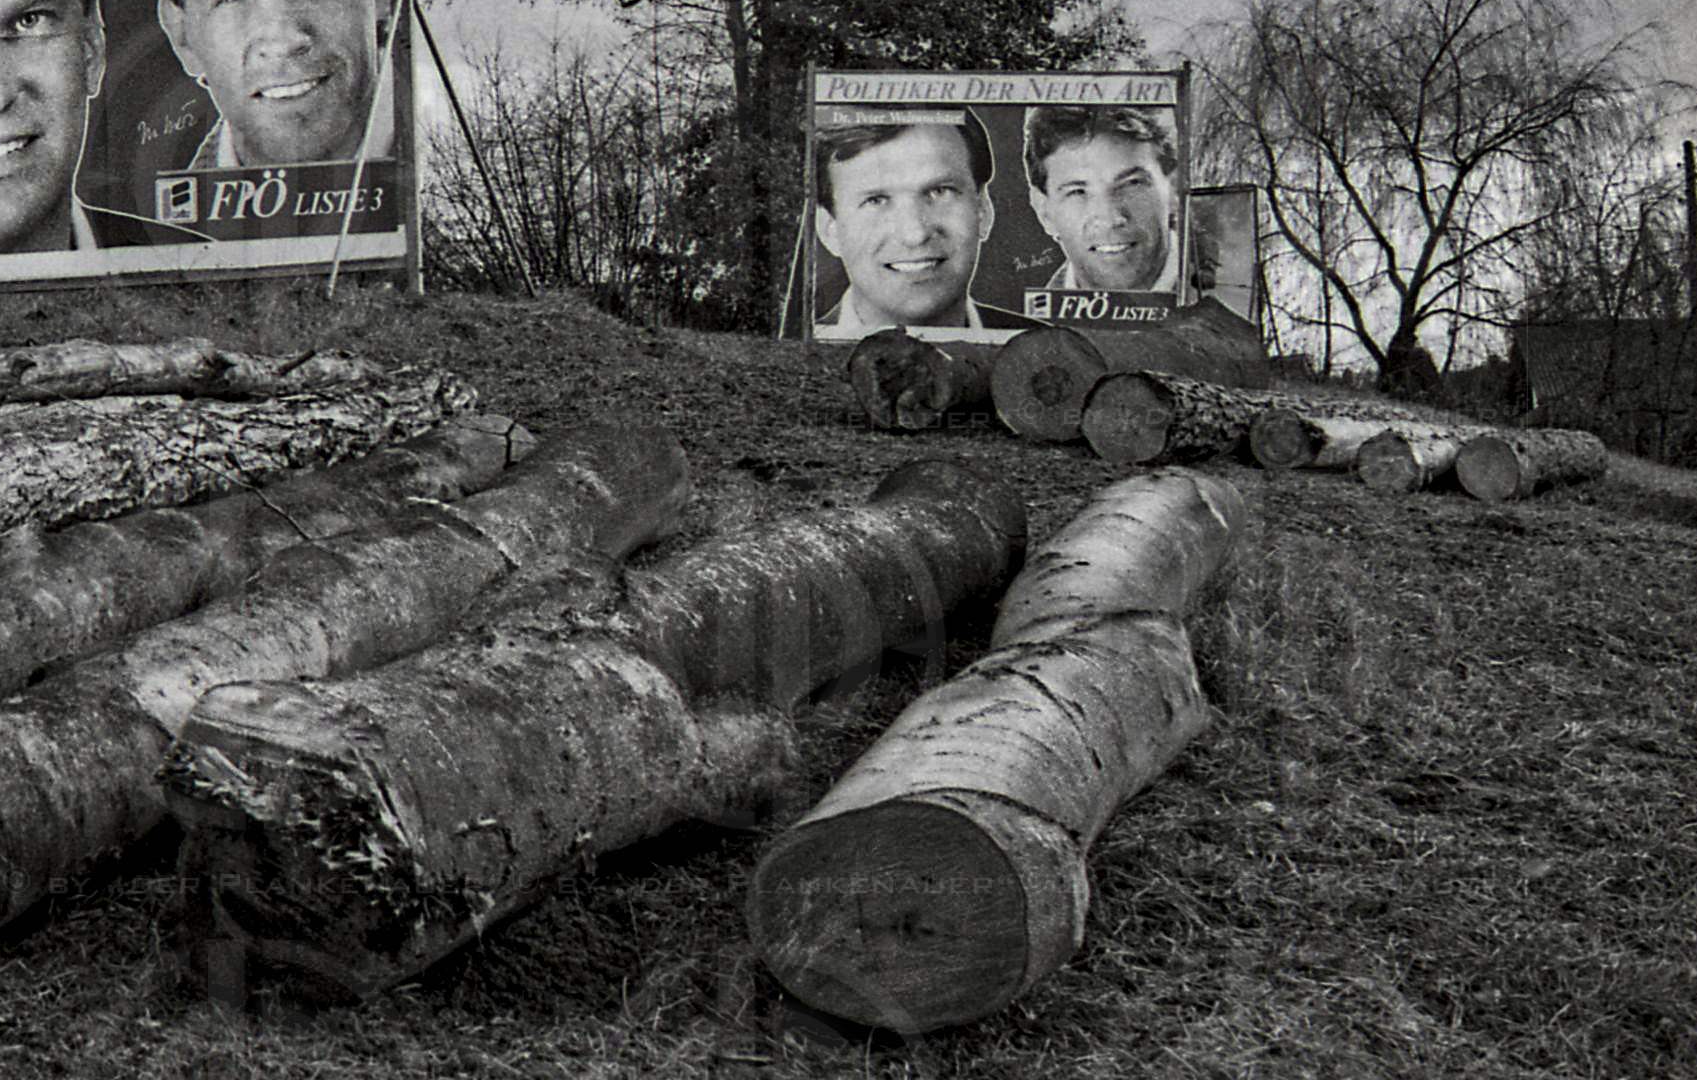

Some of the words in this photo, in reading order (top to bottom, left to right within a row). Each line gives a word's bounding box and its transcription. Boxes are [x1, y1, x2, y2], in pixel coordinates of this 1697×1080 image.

[207, 168, 288, 220] FPÖ
[293, 189, 367, 216] LISTE
[370, 187, 384, 212] 3
[1058, 291, 1110, 320] FPÖ
[1112, 306, 1159, 321] LISTE
